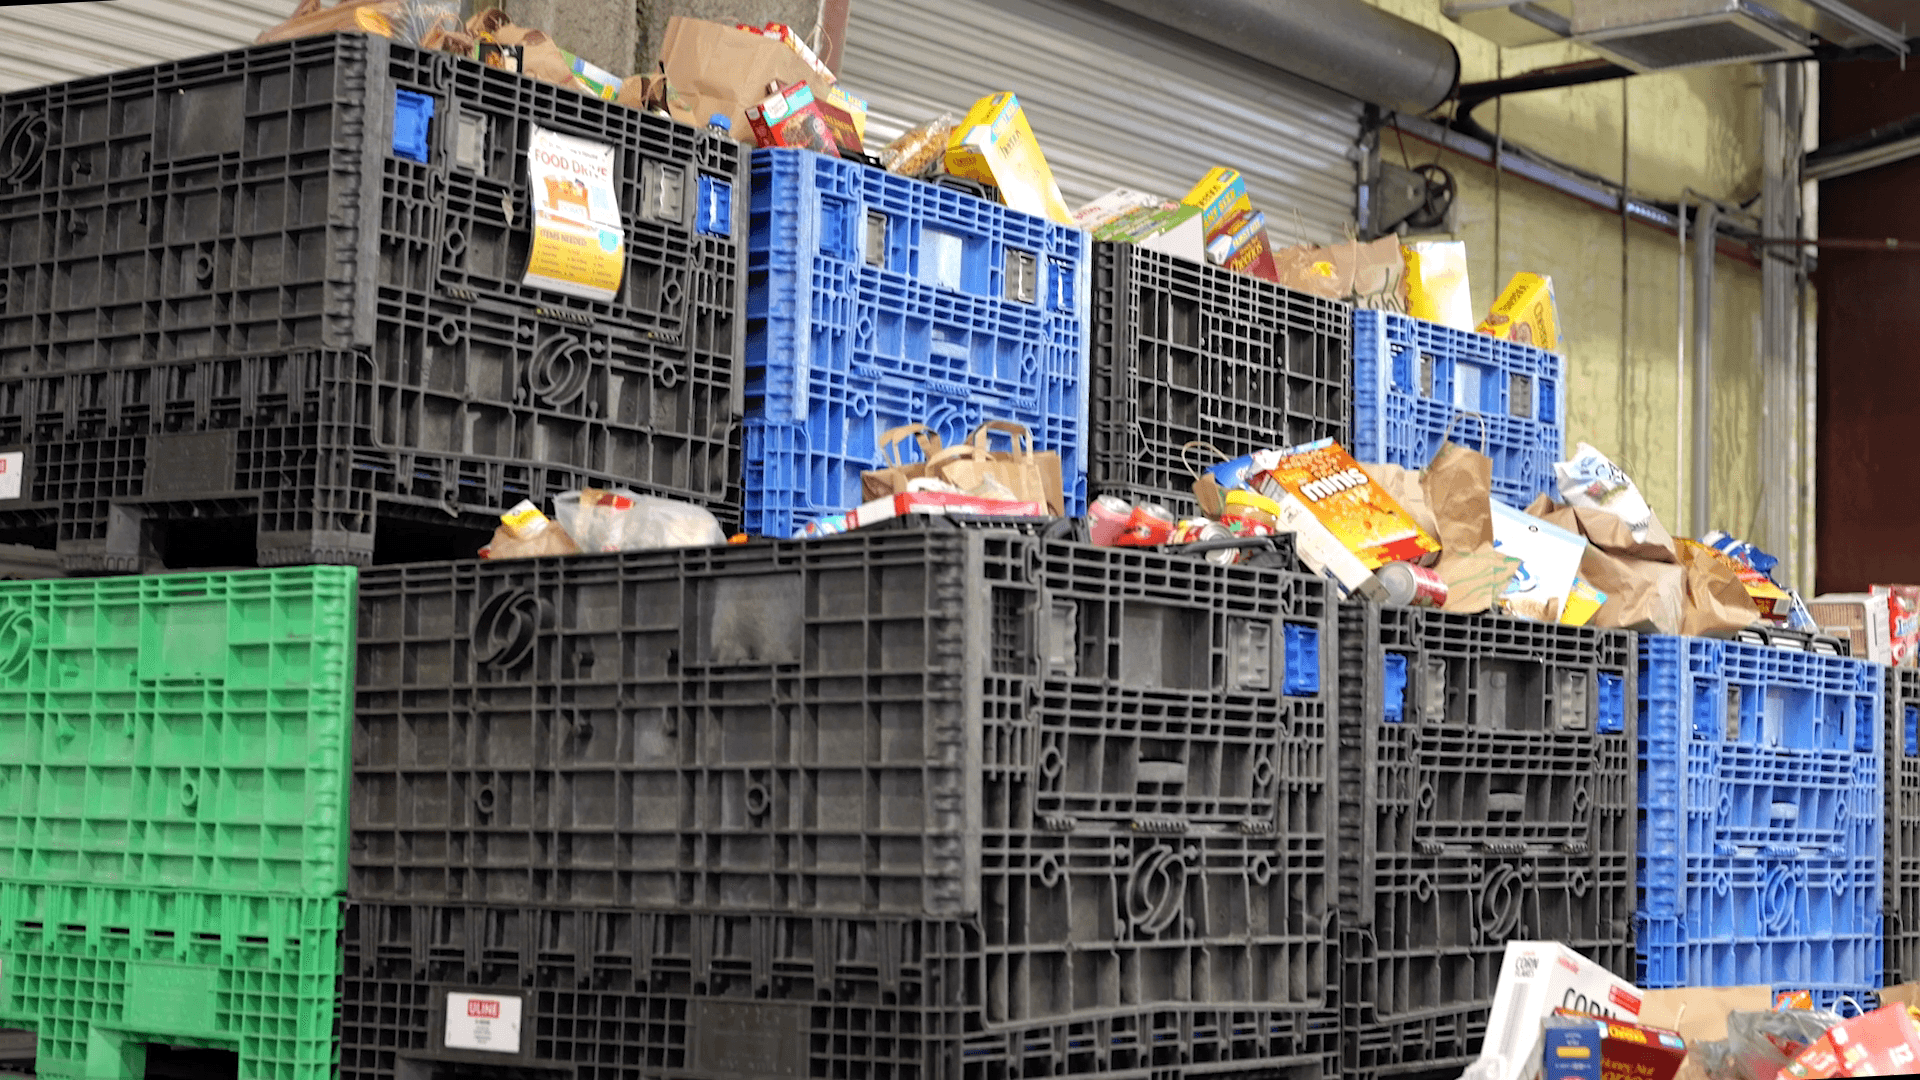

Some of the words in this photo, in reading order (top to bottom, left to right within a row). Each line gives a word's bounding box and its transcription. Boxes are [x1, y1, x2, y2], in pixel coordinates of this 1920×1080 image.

[534, 149, 570, 170] FOOD
[1299, 467, 1370, 503] minis
[1515, 956, 1540, 970] CORN
[469, 1002, 497, 1014] ULINE
